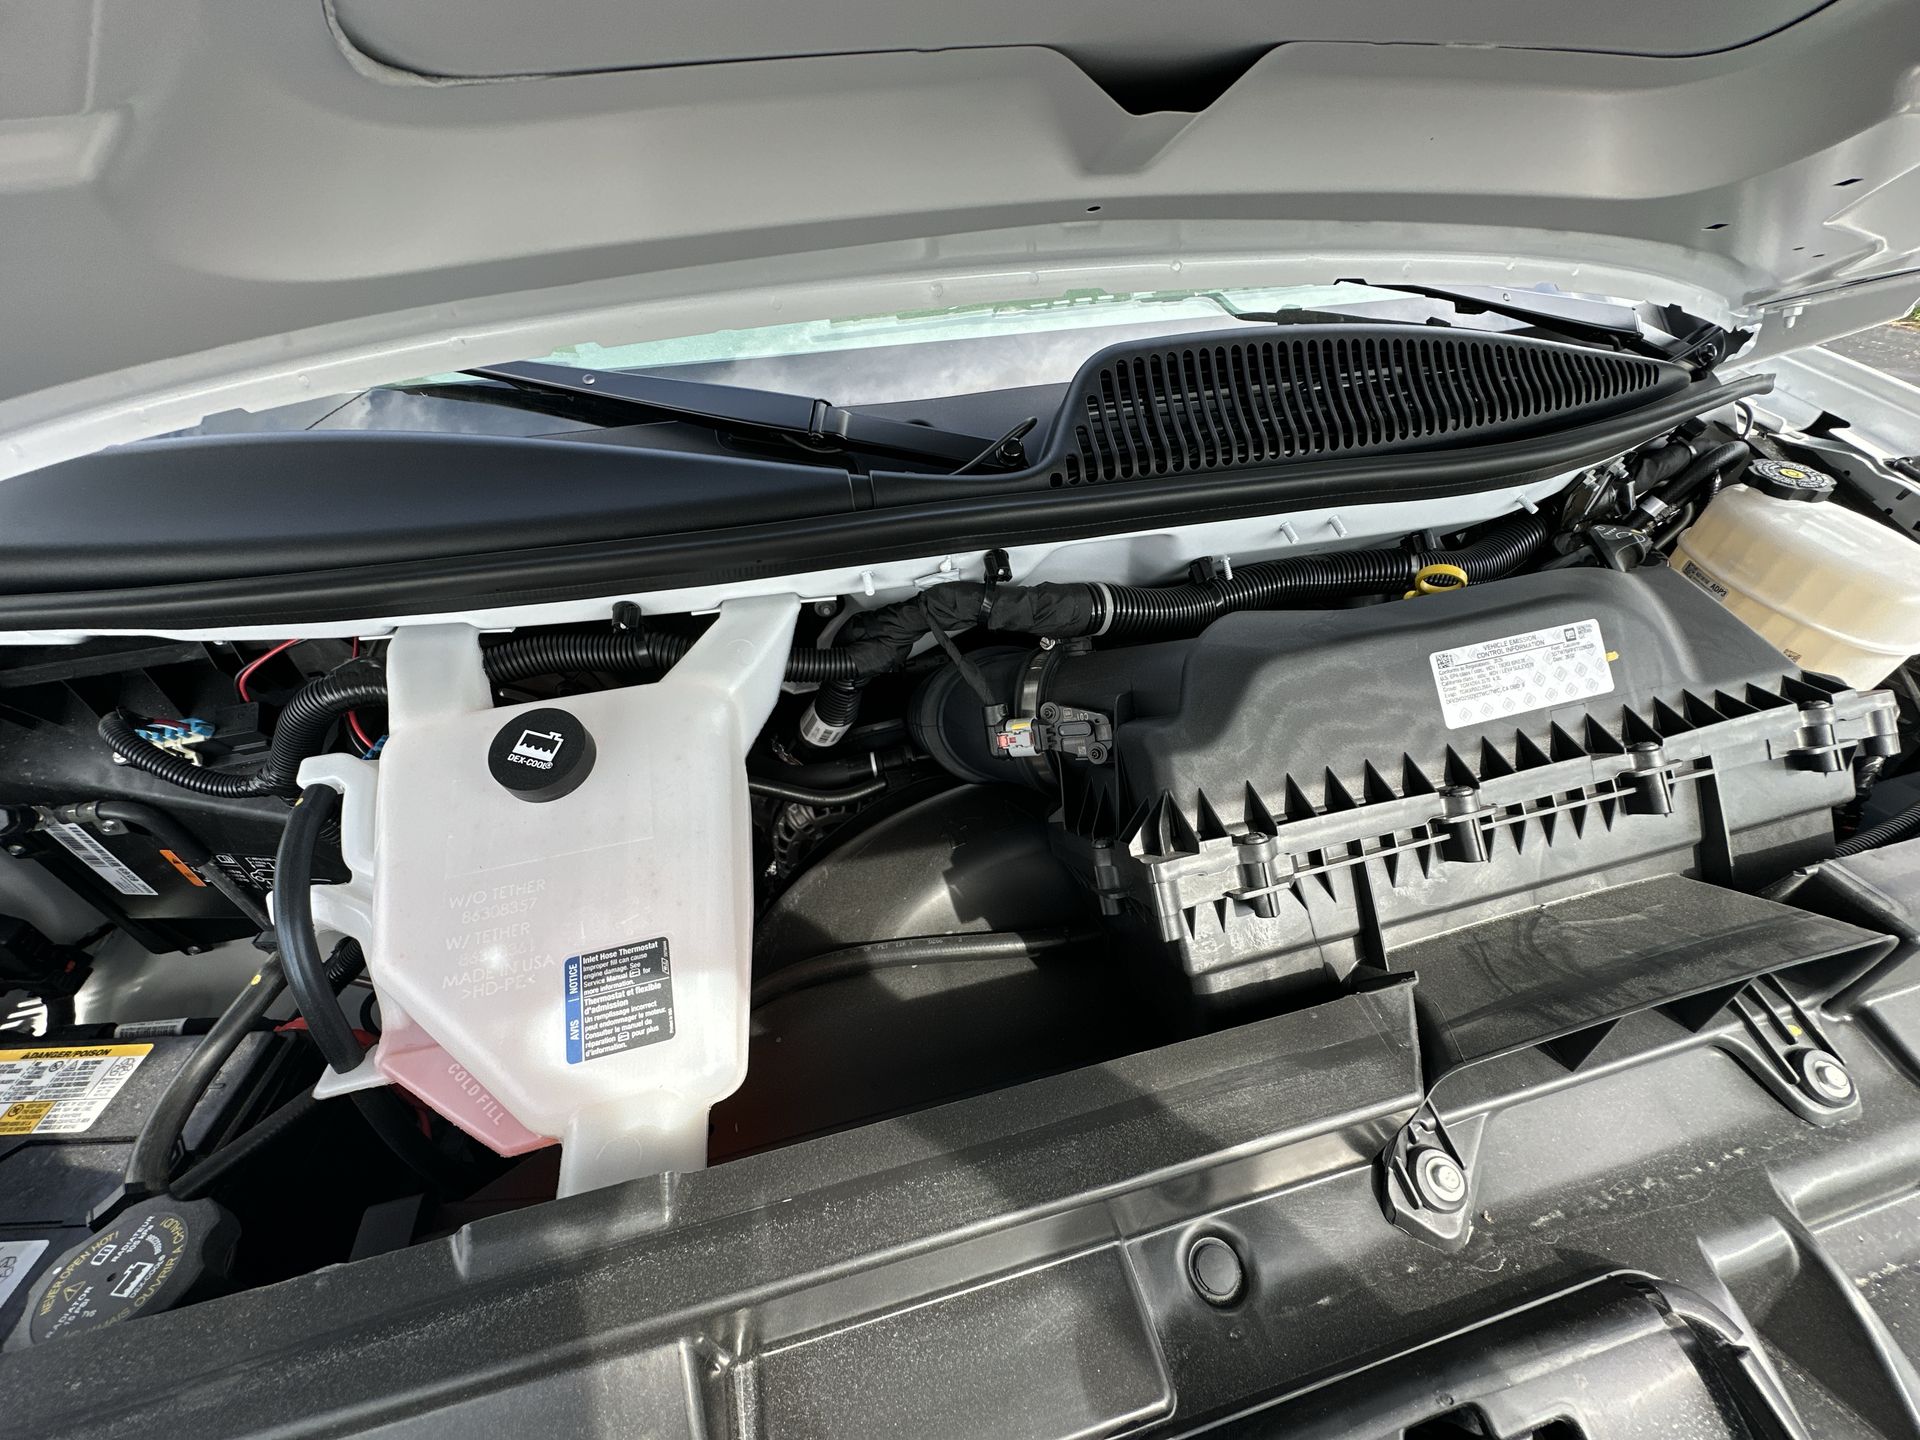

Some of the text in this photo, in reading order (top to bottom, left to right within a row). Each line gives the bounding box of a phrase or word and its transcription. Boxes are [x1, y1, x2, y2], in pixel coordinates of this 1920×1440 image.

[1710, 584, 1727, 597] ADP3
[1477, 649, 1504, 658] CONTROL
[1506, 640, 1545, 652] INFORMATION
[1483, 635, 1536, 650] VEHICLE EMISSION
[450, 879, 546, 909] W/O TETHER
[446, 922, 530, 950] W/ TETHER
[583, 956, 598, 964] Inlet
[600, 952, 618, 960] Hose
[619, 941, 658, 956] Thermostat
[442, 954, 555, 989] MADE IN USA
[583, 961, 609, 973] Improper
[610, 958, 618, 966] fill
[631, 953, 648, 961] cause
[569, 963, 578, 995] NOTICE
[584, 970, 602, 980] engine
[584, 979, 605, 988] Service
[606, 973, 628, 982] Manual
[584, 980, 635, 996] more information.
[584, 982, 661, 1006] Thermostat et flexible
[584, 1000, 628, 1015] d'admission
[594, 1008, 630, 1022] remplissage
[631, 1000, 657, 1012] incorrect
[570, 1019, 579, 1040] AVIS
[585, 1024, 598, 1034] peut
[600, 1015, 637, 1030] endommager
[585, 1027, 614, 1040] Consulter
[622, 1022, 643, 1031] manuel
[631, 1029, 645, 1039] pour
[646, 1025, 659, 1034] plus
[30, 1049, 112, 1058] DANGER/POISON
[448, 1063, 504, 1126] COLD FILL
[111, 1215, 155, 1262] RADIATEUR
[134, 1256, 178, 1307] OUVRIR
[160, 1217, 184, 1244] CHAUD!
[40, 1280, 66, 1316] NEVER
[60, 1252, 91, 1279] OPEN
[92, 1231, 119, 1251] HOT!
[74, 1298, 90, 1313] PSI
